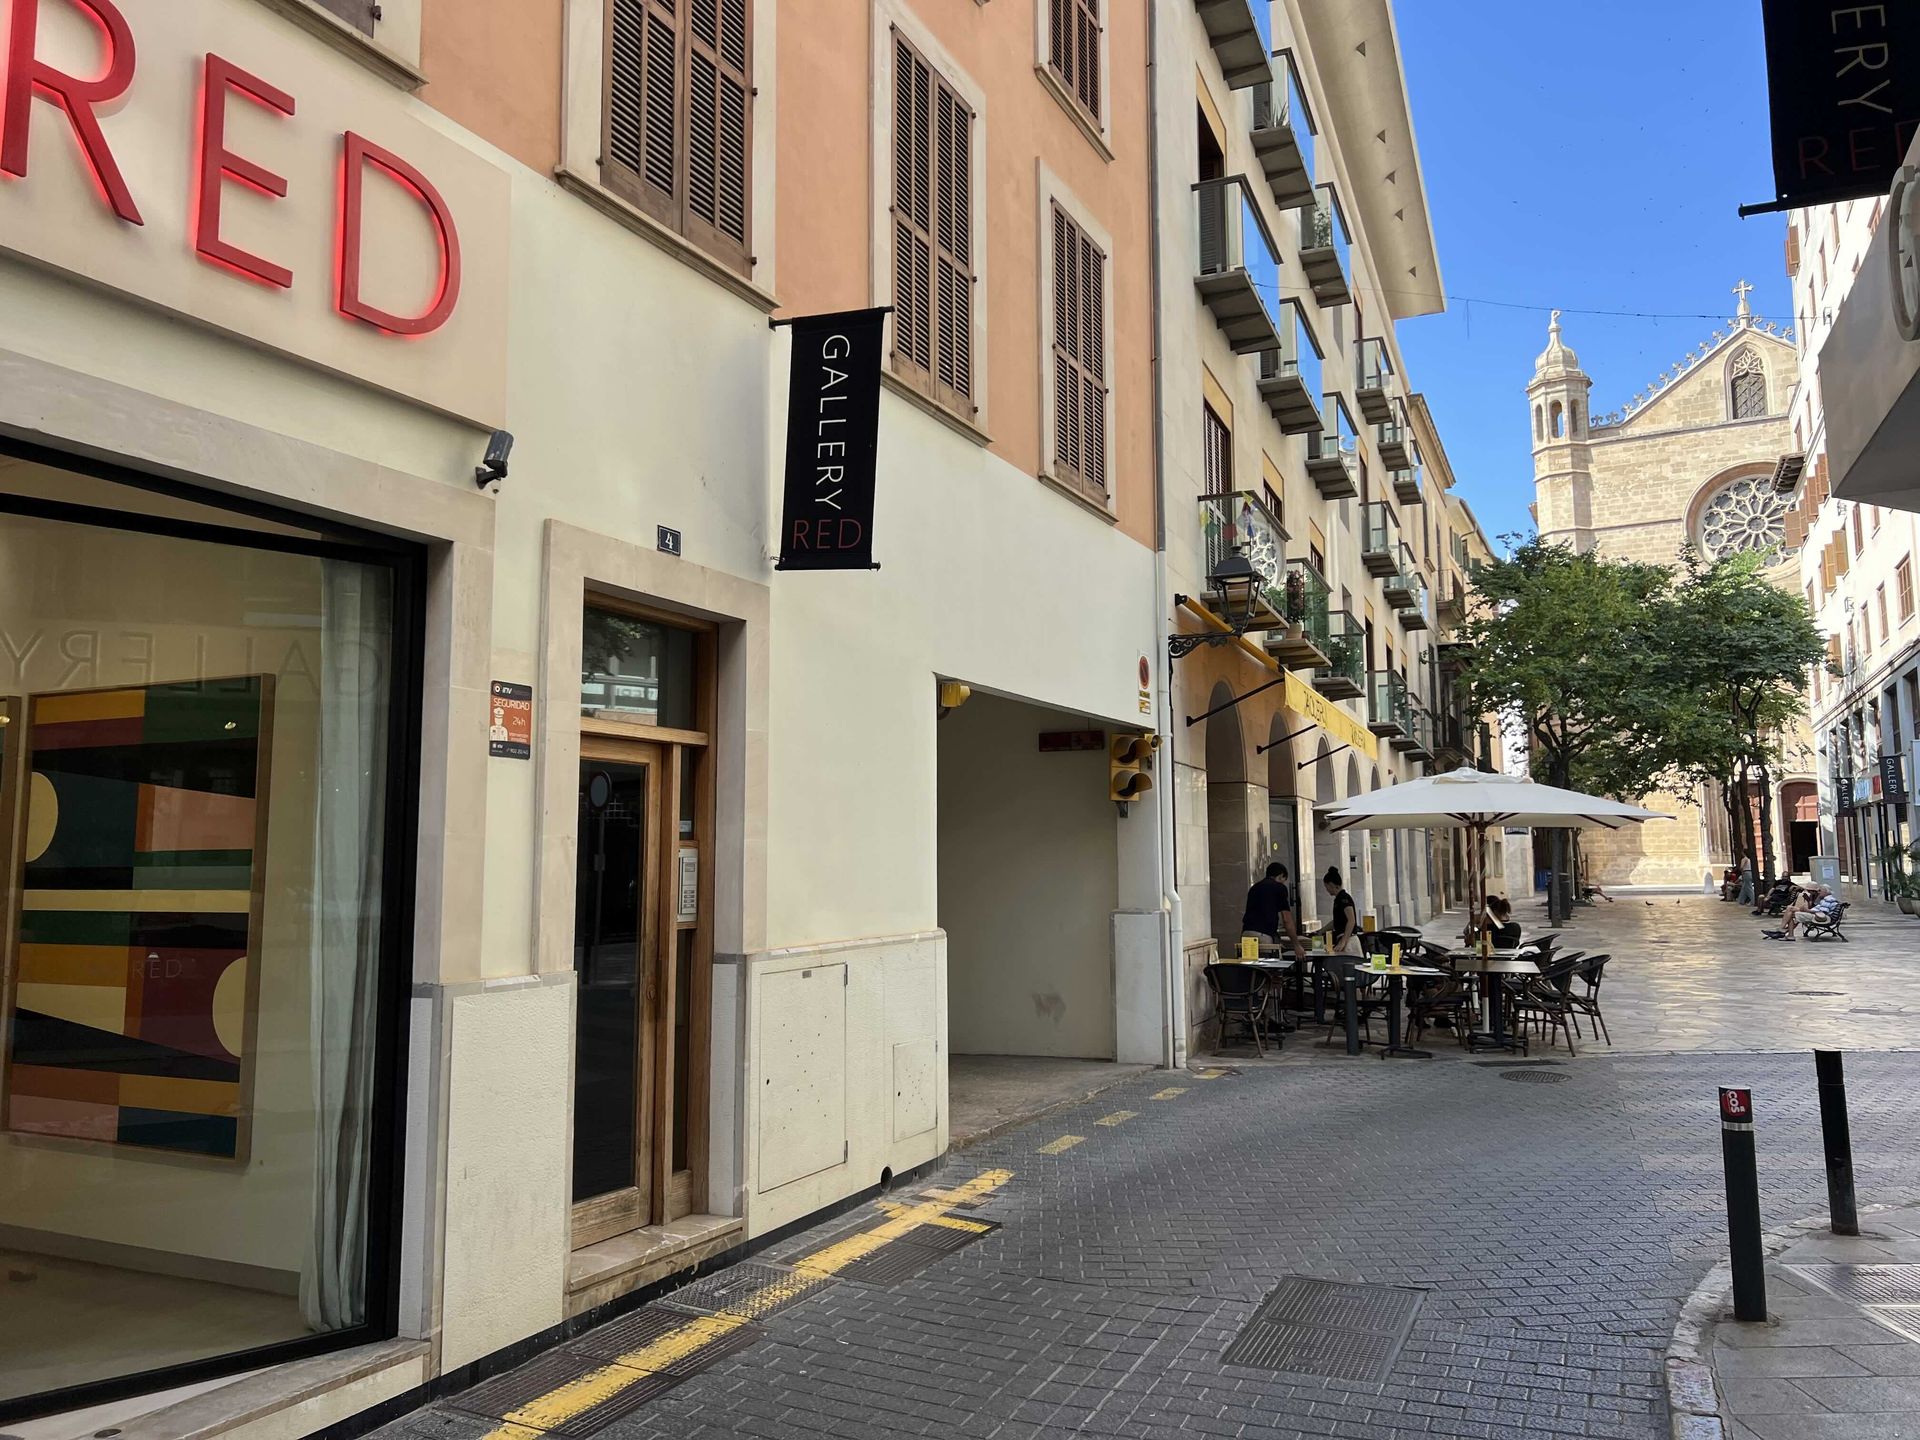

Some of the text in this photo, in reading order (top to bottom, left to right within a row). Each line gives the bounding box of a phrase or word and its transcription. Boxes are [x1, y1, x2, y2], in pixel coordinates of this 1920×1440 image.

[0, 0, 461, 335] RED
[814, 334, 850, 510] GALLERY
[665, 532, 674, 549] 4
[792, 518, 862, 549] RED
[493, 698, 530, 711] SEGURIDAD
[512, 716, 526, 726] 24h
[1886, 758, 1898, 794] GALLERY
[1840, 778, 1850, 808] GALLERY
